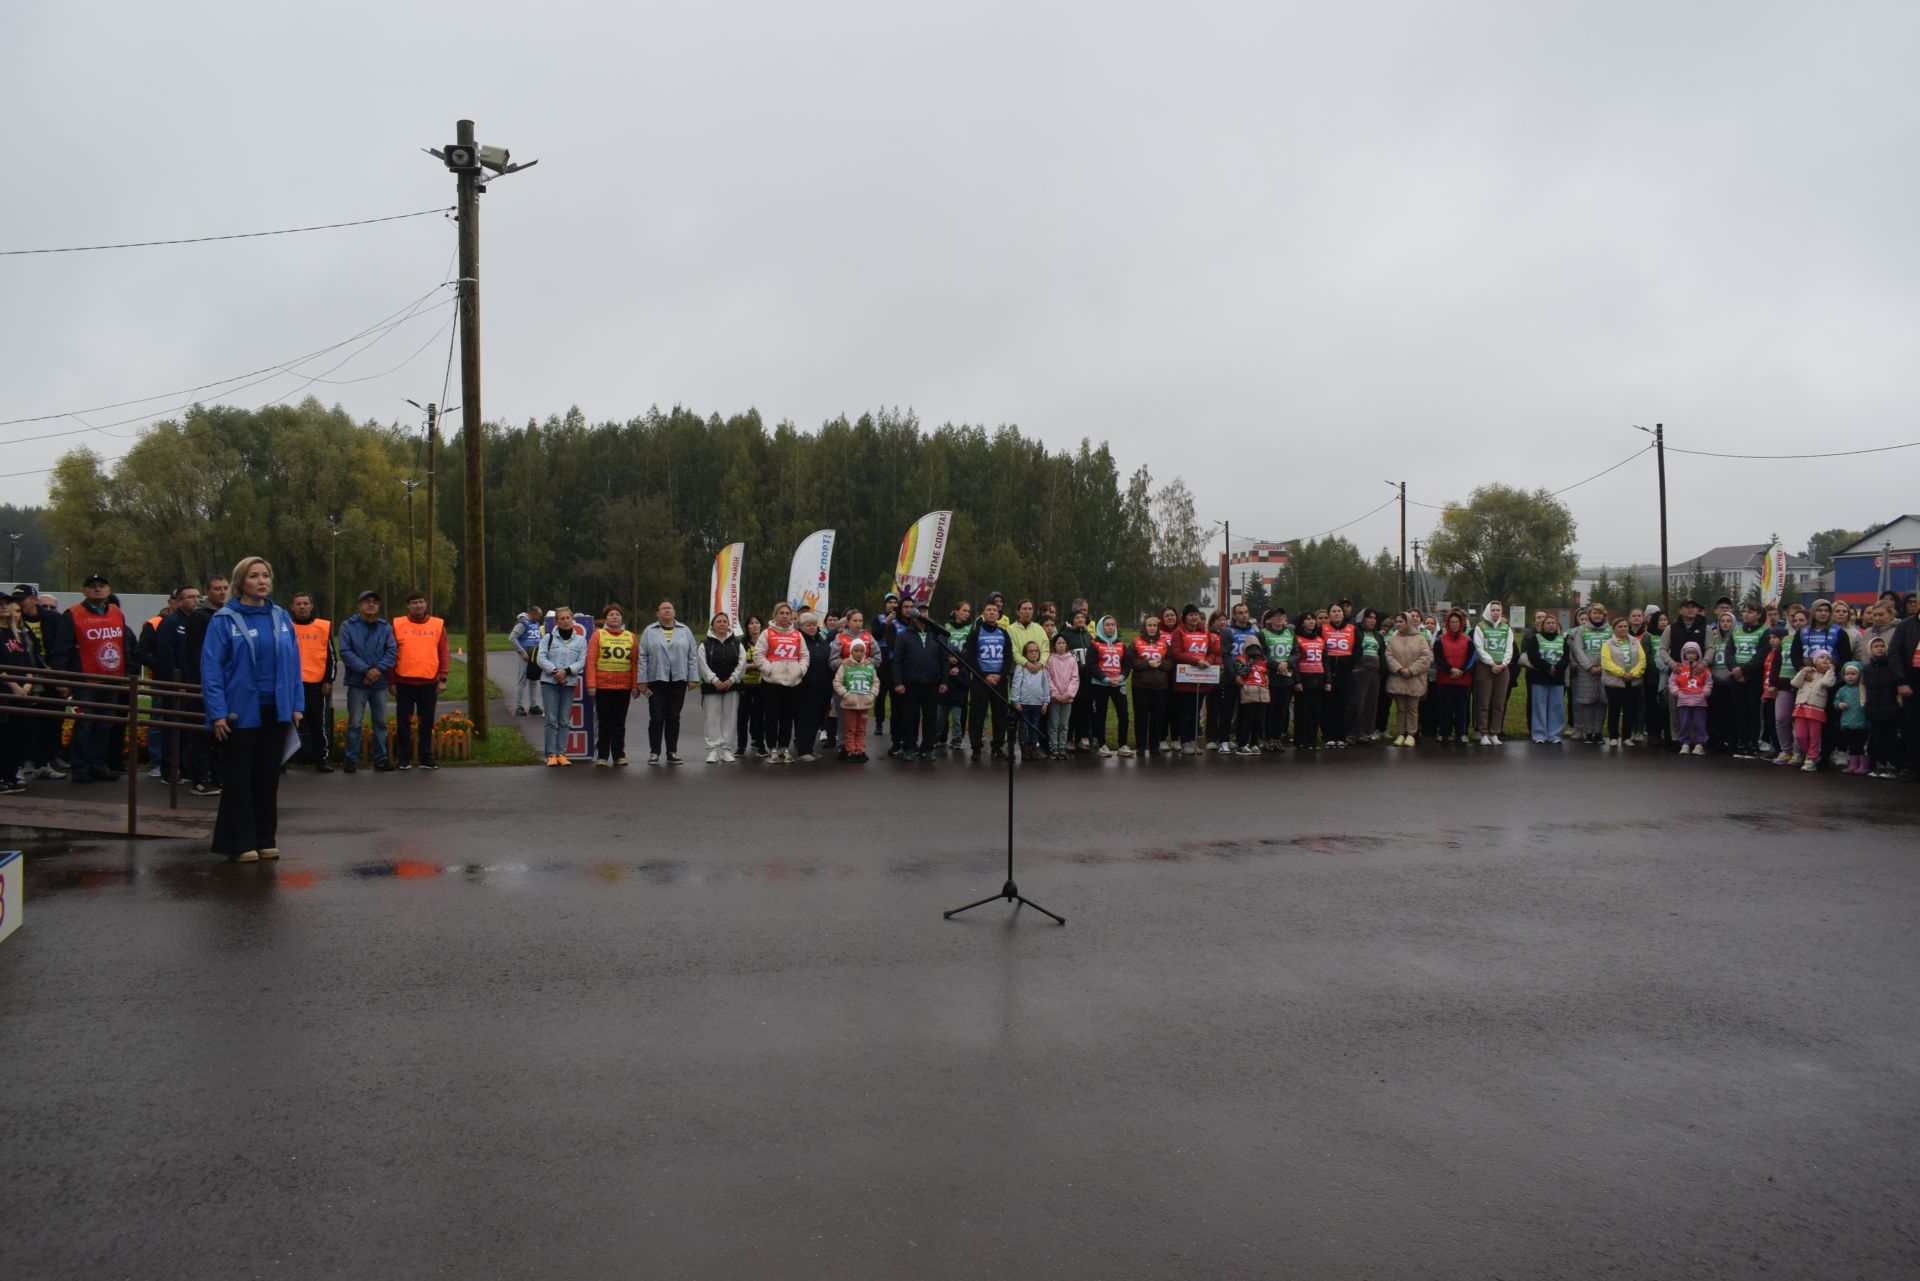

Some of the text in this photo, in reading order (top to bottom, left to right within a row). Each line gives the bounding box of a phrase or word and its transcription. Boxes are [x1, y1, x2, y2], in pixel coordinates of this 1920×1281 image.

[820, 534, 832, 571] СПОРТ!
[927, 549, 941, 580] РИТМЕ
[934, 511, 948, 549] СПОРТА!
[730, 557, 740, 629] ТУКАЕВСКИЙ РАЙОН
[86, 626, 122, 640] СУДЬЯ
[774, 643, 797, 658] 47
[1188, 642, 1208, 654] 44
[1268, 644, 1293, 657] 109
[1326, 638, 1349, 650] 56
[1483, 637, 1506, 650] 134
[601, 646, 632, 660] 302
[979, 644, 1004, 659] 212
[1306, 649, 1322, 661] 55
[1102, 653, 1121, 667] 28
